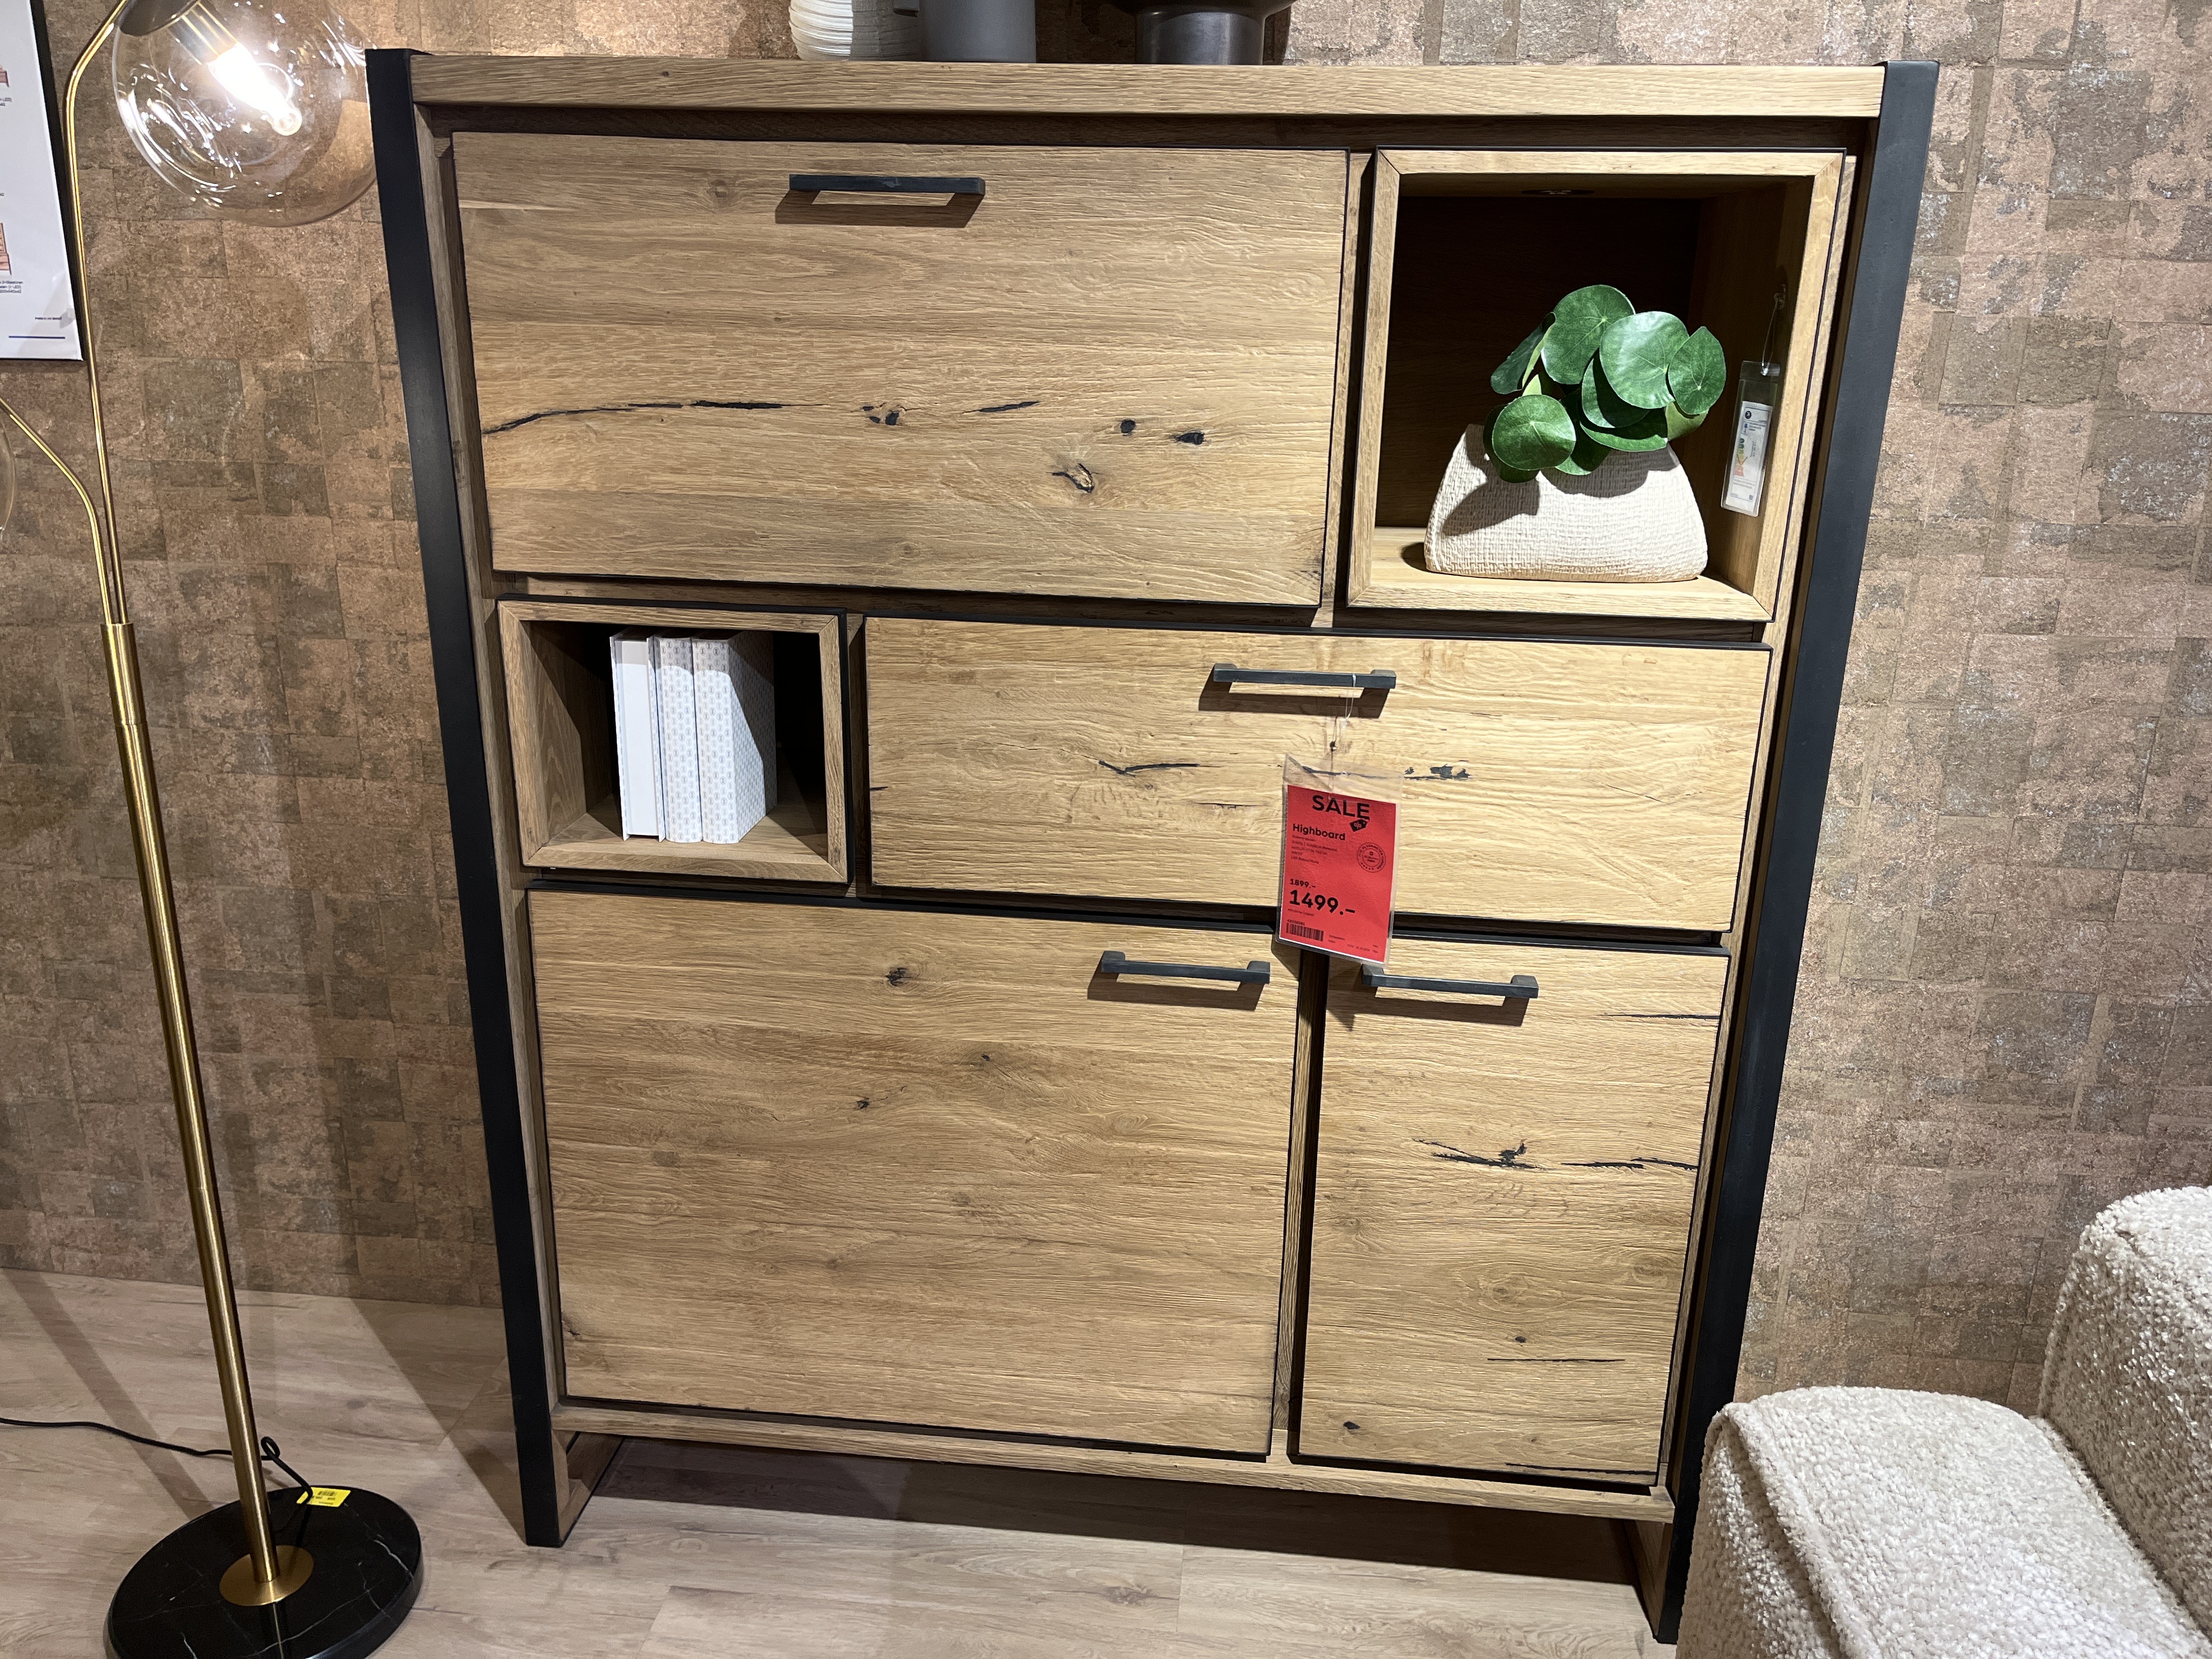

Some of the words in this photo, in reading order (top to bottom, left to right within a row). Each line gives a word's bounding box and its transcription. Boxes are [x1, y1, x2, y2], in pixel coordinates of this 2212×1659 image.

[1312, 795, 1370, 820] SALE
[1293, 823, 1346, 841] Highboard
[1290, 878, 1316, 888] 1899.-
[1289, 889, 1356, 916] 1499.-
